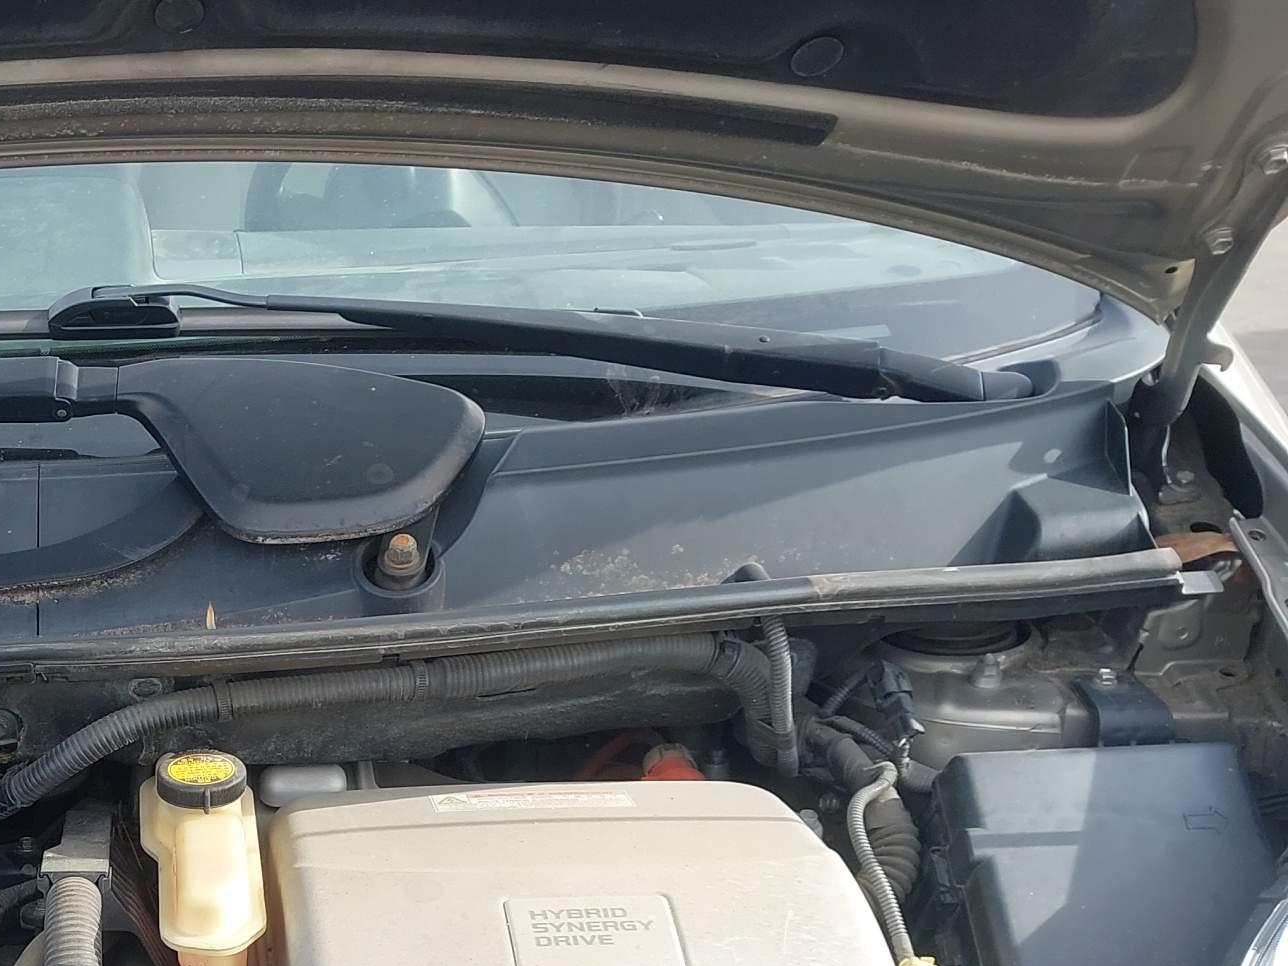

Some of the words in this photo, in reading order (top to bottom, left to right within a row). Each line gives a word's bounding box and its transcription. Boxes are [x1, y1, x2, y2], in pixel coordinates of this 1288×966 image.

[528, 907, 628, 920] HYBRID
[531, 920, 654, 933] SYNERGY
[535, 934, 615, 947] DRIVE
